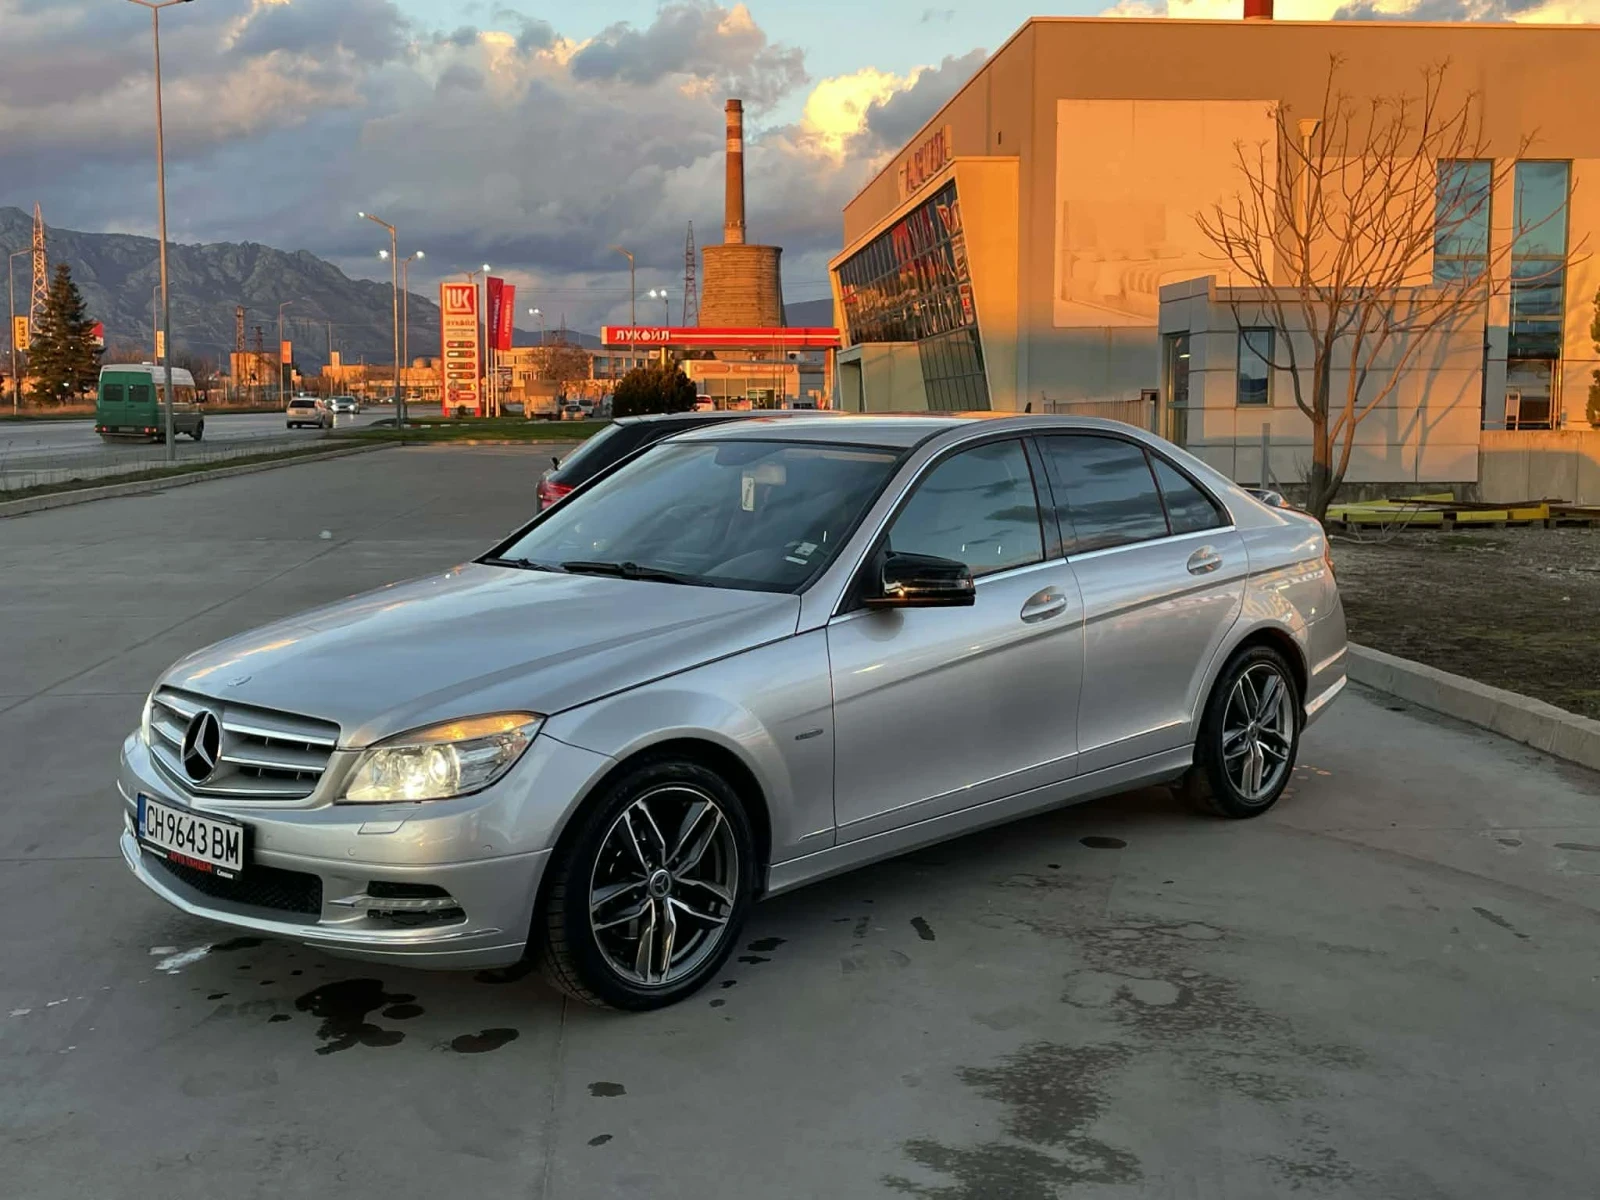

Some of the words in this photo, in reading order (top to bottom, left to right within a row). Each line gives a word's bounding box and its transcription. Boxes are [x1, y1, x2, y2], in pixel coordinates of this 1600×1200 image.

[615, 327, 670, 341] ЛУКОЙЛ
[146, 805, 165, 841] CH
[167, 813, 207, 854] 9643
[212, 827, 239, 864] BM
